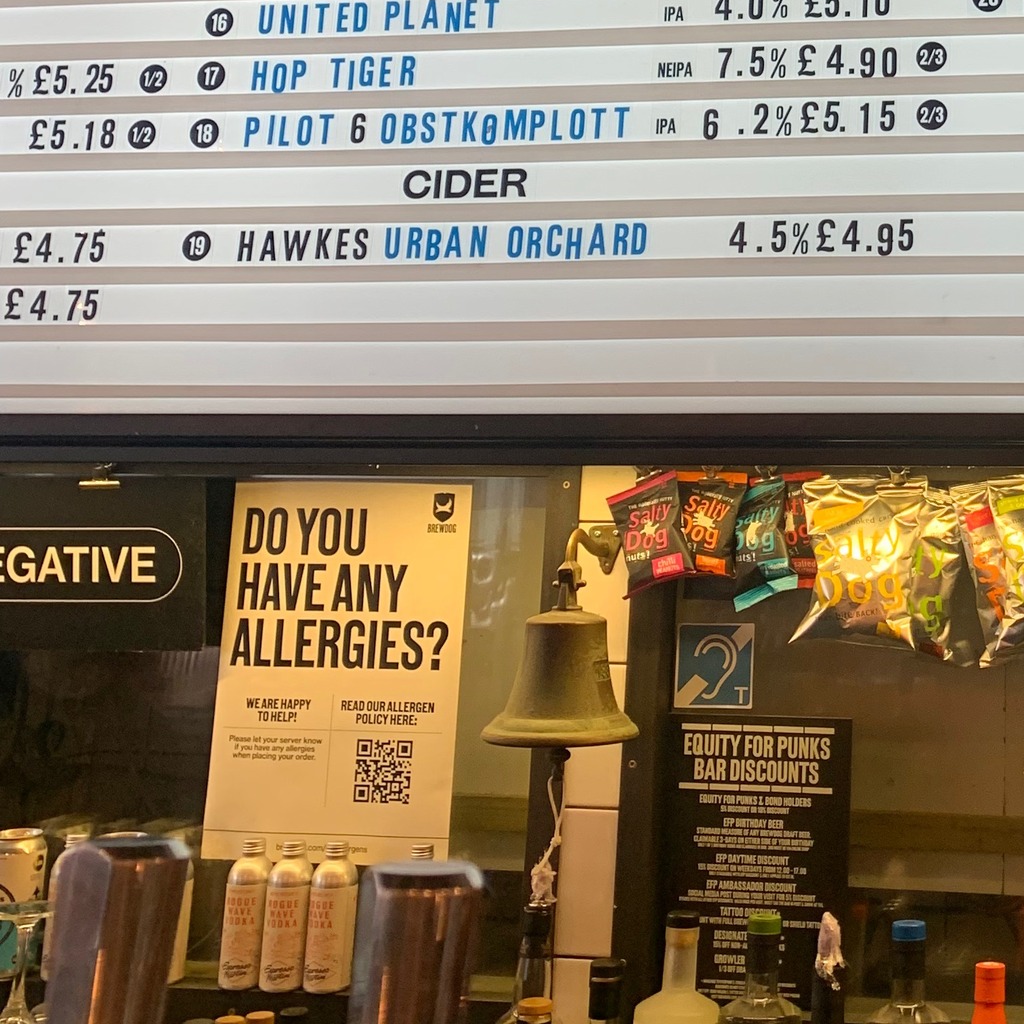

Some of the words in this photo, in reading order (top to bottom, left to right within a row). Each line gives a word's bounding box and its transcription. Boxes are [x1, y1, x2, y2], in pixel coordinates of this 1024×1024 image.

[664, 6, 684, 22] IPA
[243, 113, 335, 148] PILOT
[655, 118, 676, 135] IPA
[403, 168, 528, 200] CIDER
[237, 228, 369, 262] HAWKES
[384, 225, 488, 261] URBAN
[507, 222, 648, 260] ORCHARD
[242, 507, 289, 555] DO
[296, 508, 368, 556] YOU
[427, 524, 457, 533] BREWDOG
[0, 546, 156, 584] GATIVE
[236, 562, 325, 611] HAVE
[331, 563, 409, 613] ANY
[229, 618, 450, 671] ALLERGIES?
[247, 698, 261, 709] WE
[261, 698, 279, 709] ARE
[280, 699, 311, 710] HAPPY
[341, 700, 364, 712] READ
[366, 701, 385, 712] OUR
[387, 702, 435, 713] ALLERGEN
[258, 711, 270, 722] TO
[270, 712, 297, 723] HELP!
[356, 714, 389, 725] POLICY
[390, 715, 417, 726] HERE:
[229, 735, 251, 743] Please
[253, 735, 261, 743] let
[262, 737, 278, 745] your
[303, 737, 322, 745] know
[684, 733, 741, 756] EQUITY
[744, 735, 774, 758] FOR
[777, 736, 831, 760] PUNKS
[254, 744, 270, 752] have
[285, 745, 315, 754] allergies
[252, 752, 277, 761] placing
[295, 753, 316, 761] order.
[693, 758, 726, 781] BAR
[730, 759, 819, 784] DISCOUNTS
[699, 794, 722, 804] EQUITY
[723, 795, 735, 805] FOR
[736, 795, 757, 805] PUNKS
[765, 796, 782, 806] BOND
[783, 797, 811, 807] HOLDERS
[736, 818, 767, 828] BIRTHDAY
[768, 819, 783, 829] BEER
[728, 854, 756, 864] DAYTIME
[757, 856, 789, 866] DISCOUNT
[719, 880, 764, 892] AMBASSADOR
[765, 883, 797, 893] DISCOUNT
